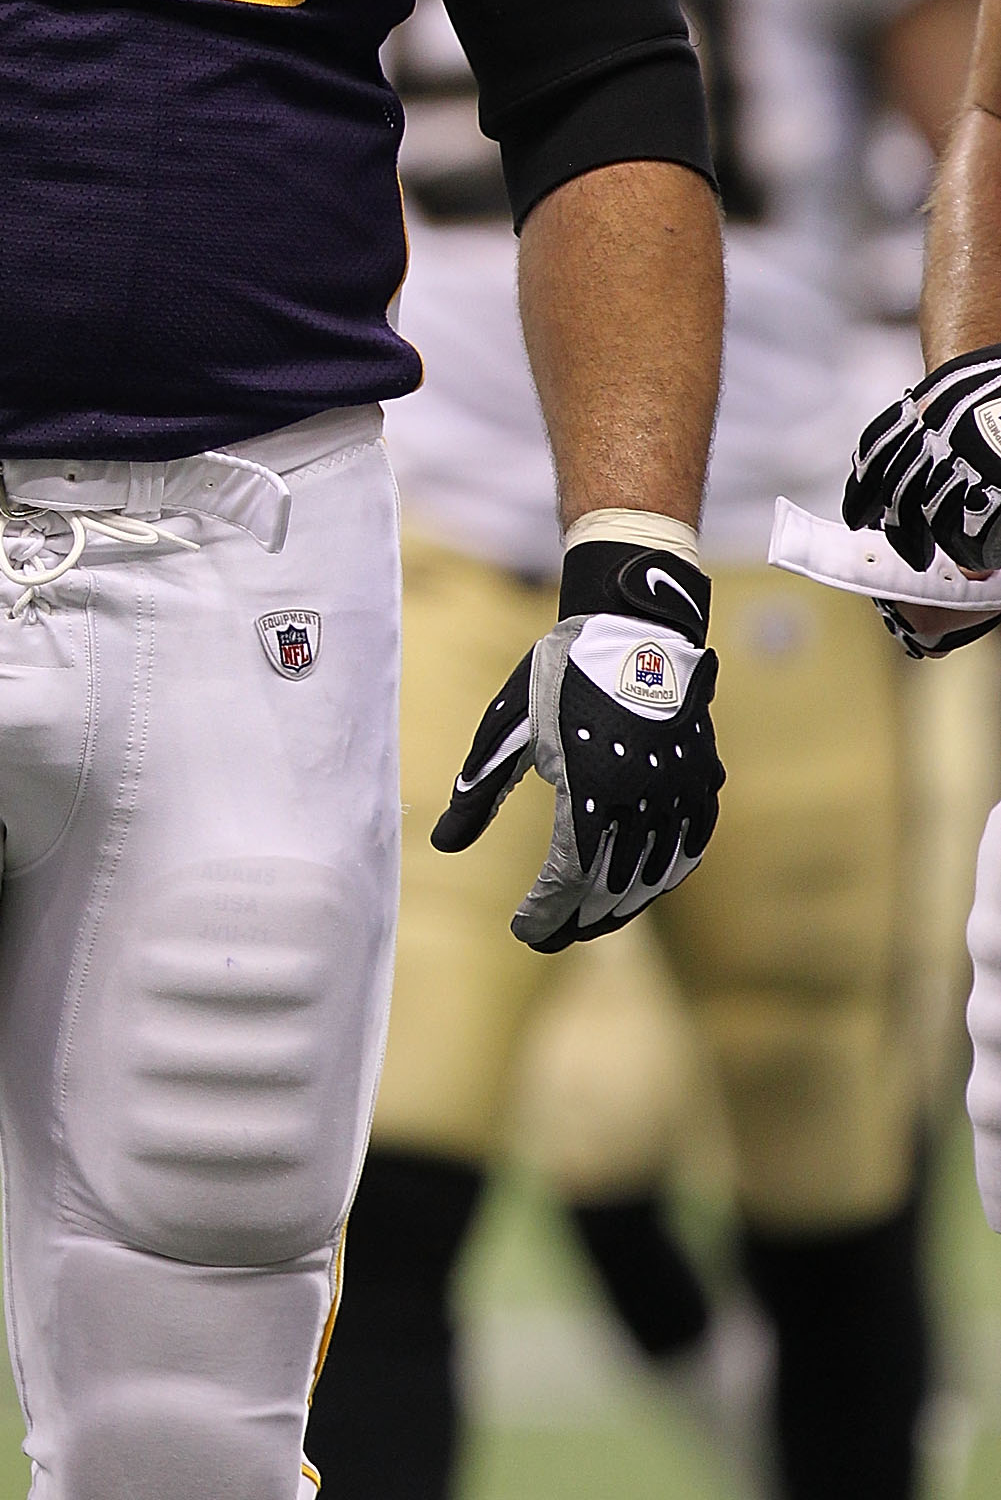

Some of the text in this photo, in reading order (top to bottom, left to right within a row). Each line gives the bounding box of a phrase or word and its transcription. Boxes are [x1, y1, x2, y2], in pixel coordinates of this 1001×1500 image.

[262, 612, 317, 632] EQUIPMENT
[281, 643, 309, 666] NFL
[638, 652, 662, 673] NFL
[625, 682, 674, 700] EQUIPMENT
